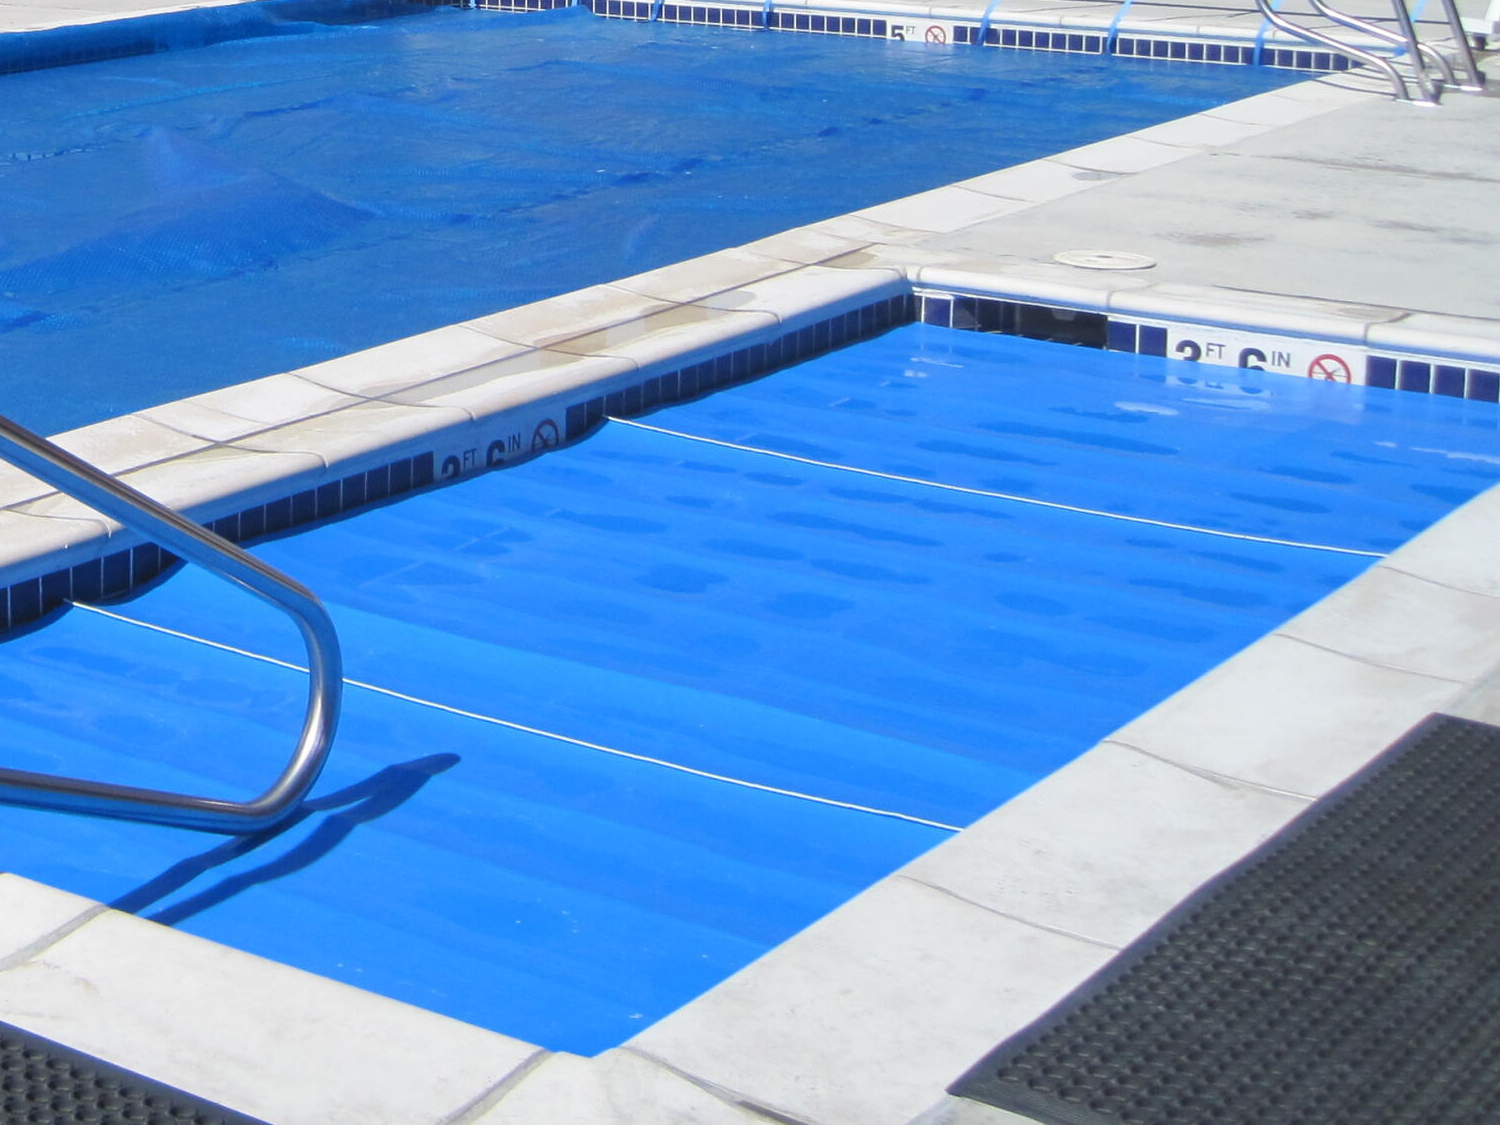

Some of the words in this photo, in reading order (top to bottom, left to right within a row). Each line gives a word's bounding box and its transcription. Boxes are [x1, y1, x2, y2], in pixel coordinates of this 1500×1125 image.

[891, 24, 905, 41] 5
[905, 25, 916, 35] FT
[1205, 342, 1226, 360] FT
[1271, 350, 1291, 368] IN
[463, 447, 477, 468] FT
[508, 431, 521, 453] IN
